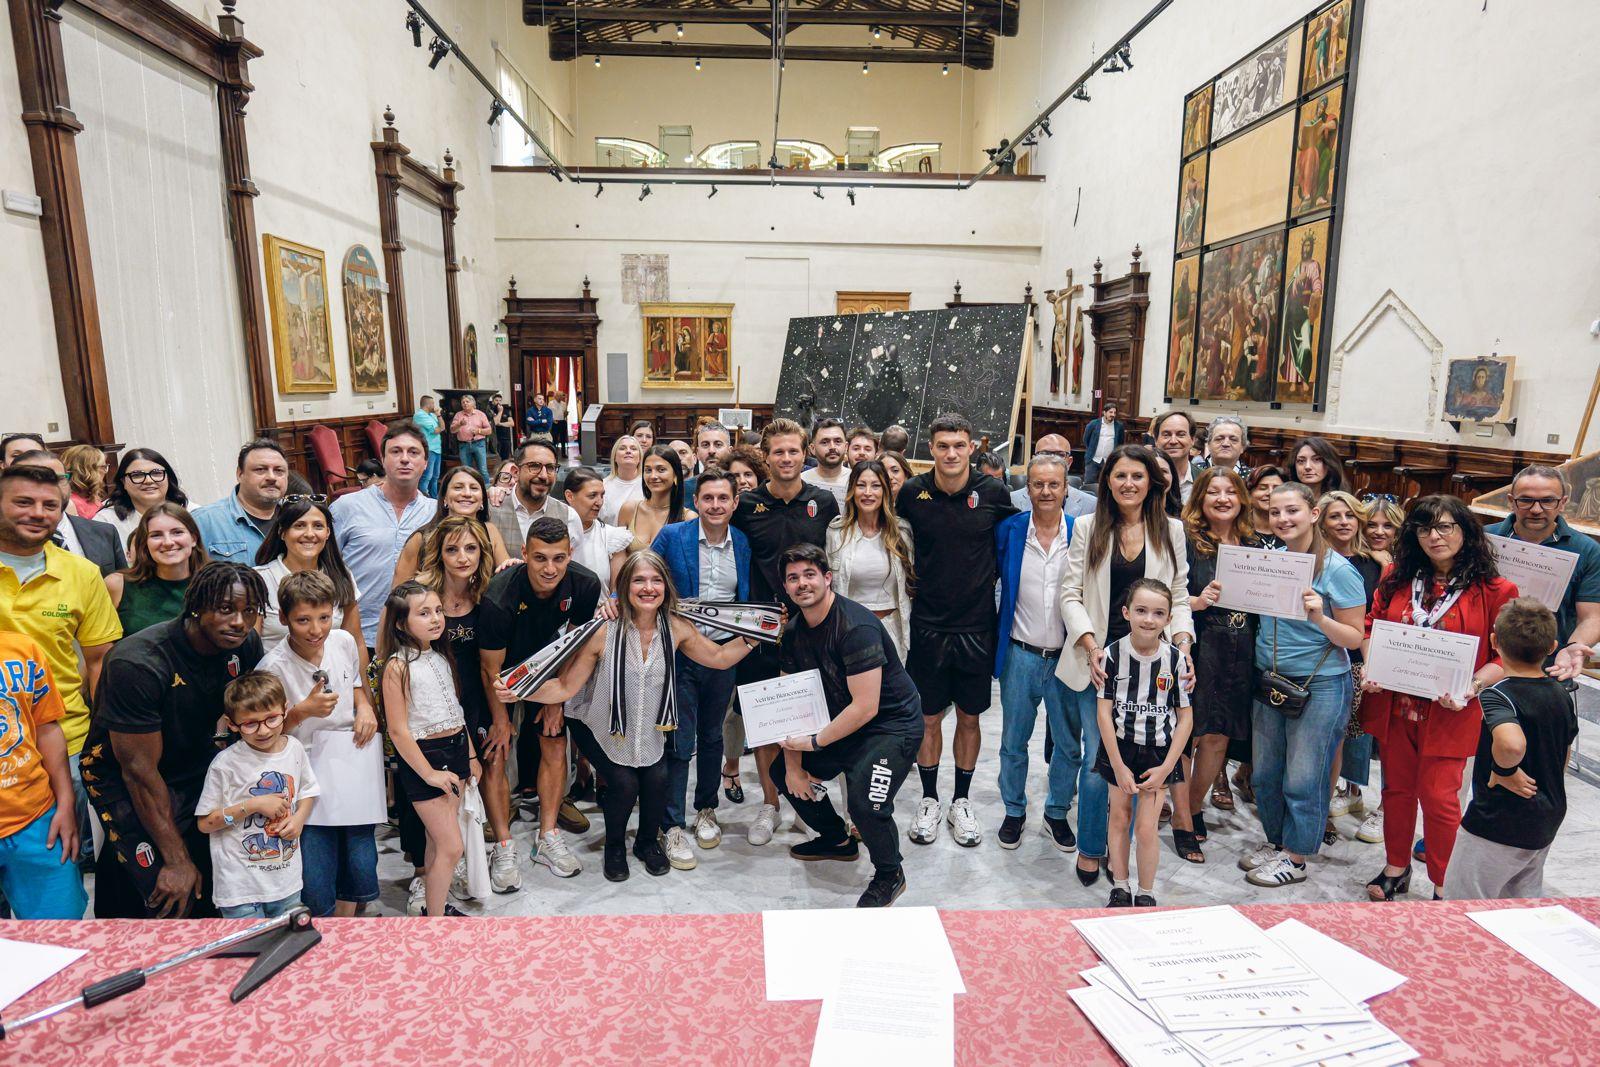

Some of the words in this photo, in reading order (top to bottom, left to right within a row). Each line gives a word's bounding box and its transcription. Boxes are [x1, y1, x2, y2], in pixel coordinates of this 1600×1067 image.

[1233, 562, 1257, 572] Vetrine
[1257, 565, 1296, 576] Bianconere
[1512, 556, 1553, 571] Bianconere
[41, 610, 77, 619] COLDIRETT
[1388, 639, 1414, 649] Vetrine
[1414, 644, 1456, 657] Bianconere
[755, 694, 775, 704] Vetrine
[776, 687, 808, 700] Bianconere
[1116, 700, 1167, 714] Fainplast
[868, 764, 893, 802] AERO
[1148, 954, 1218, 968] Bianconere
[1219, 951, 1263, 961] Vetrine
